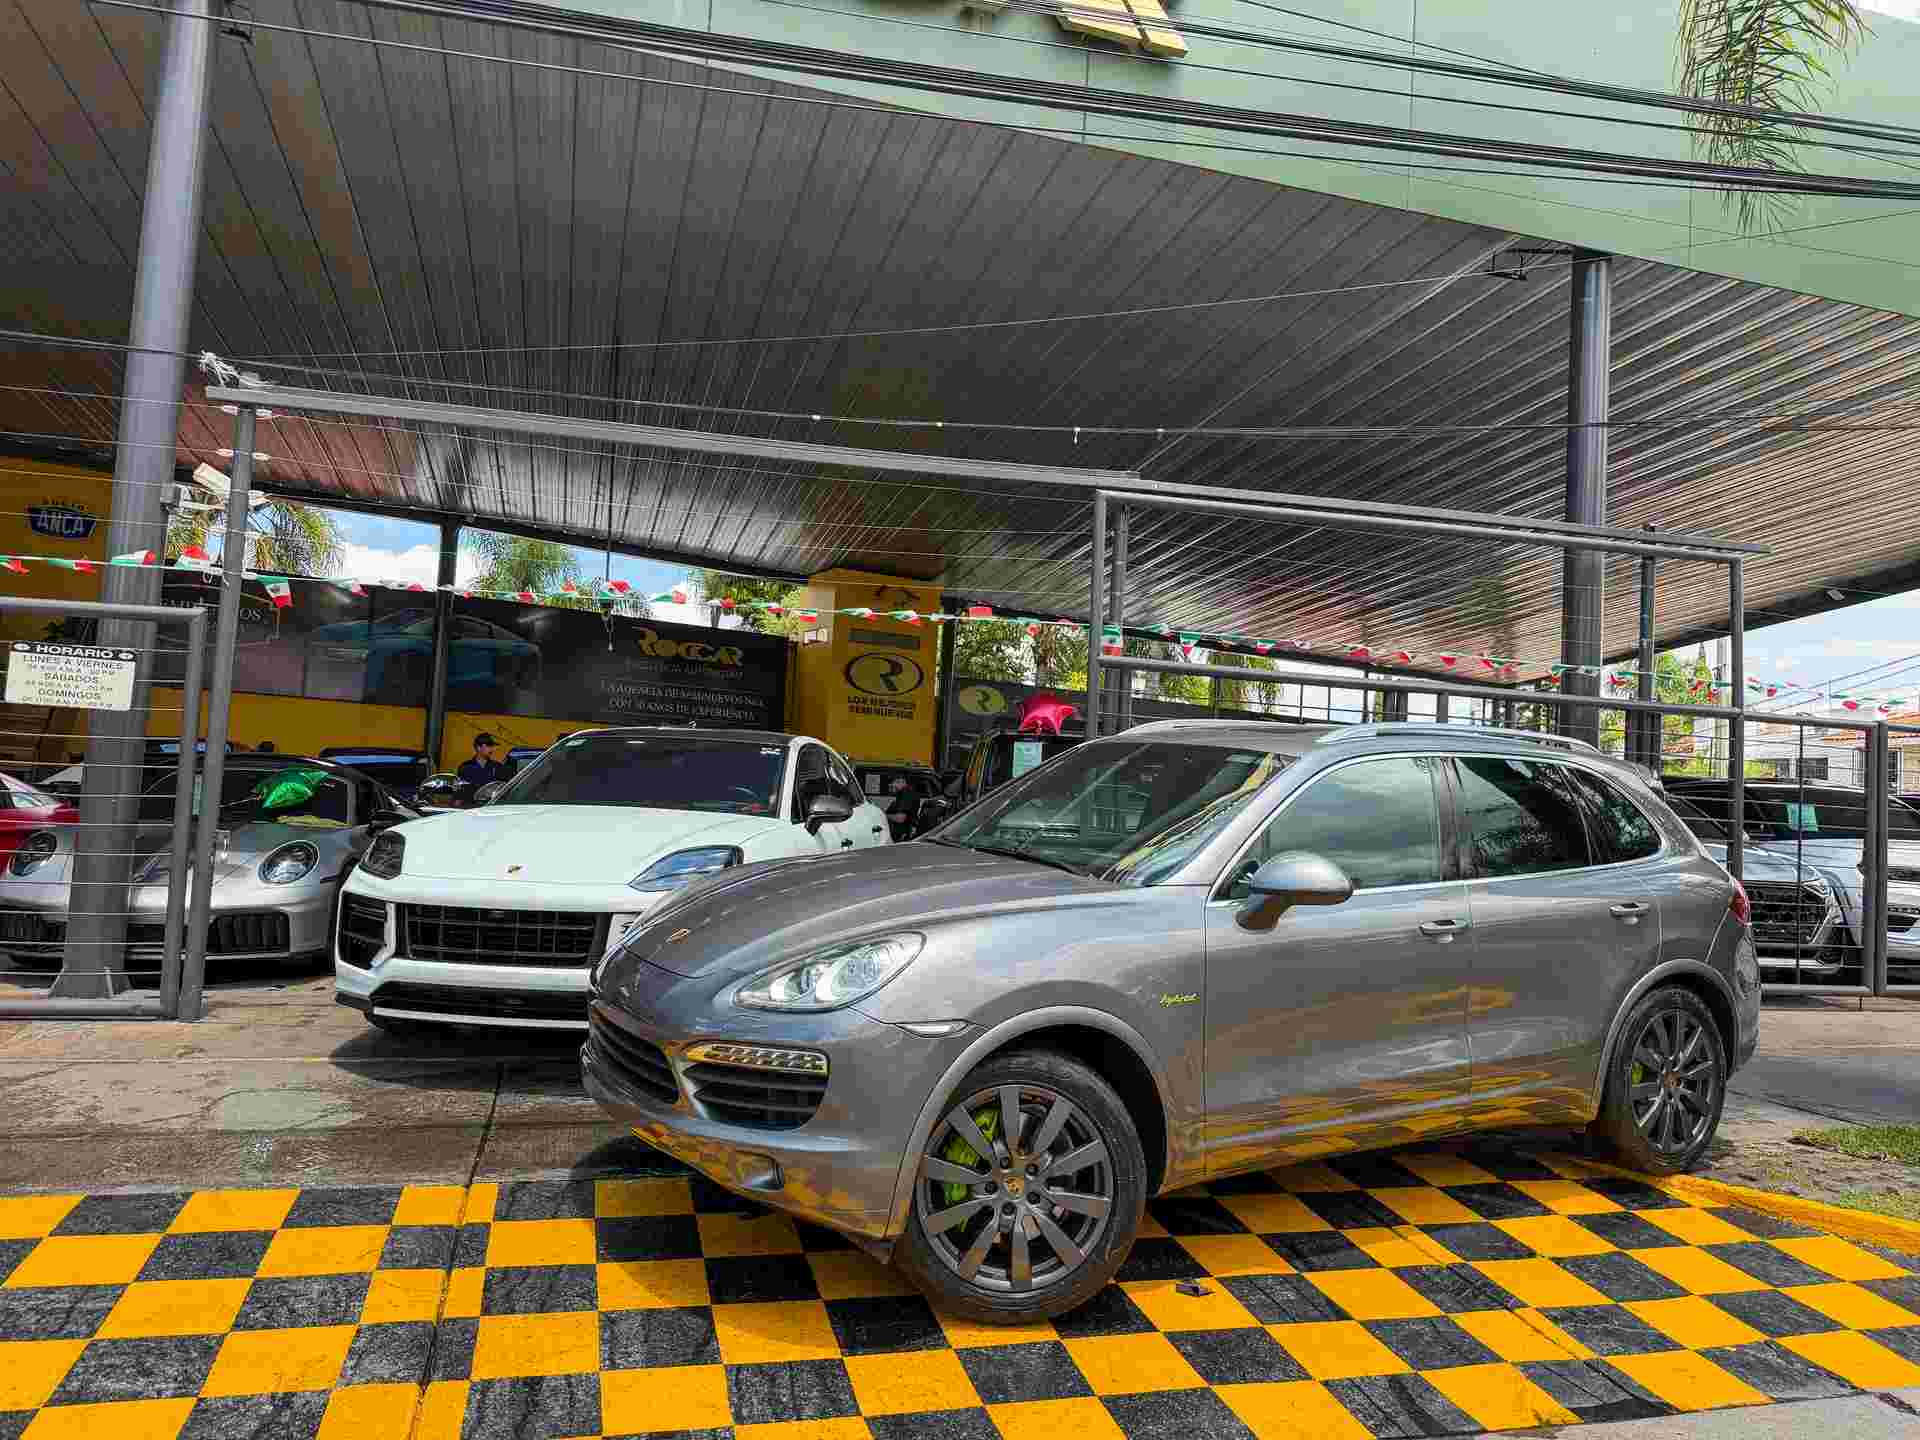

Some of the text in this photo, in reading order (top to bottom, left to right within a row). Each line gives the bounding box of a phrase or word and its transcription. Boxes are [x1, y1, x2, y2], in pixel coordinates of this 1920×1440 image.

[35, 642, 114, 659] HORARIO
[24, 654, 60, 665] LUNES
[76, 658, 124, 670] VIERNES
[38, 688, 102, 700] DOMINGOS
